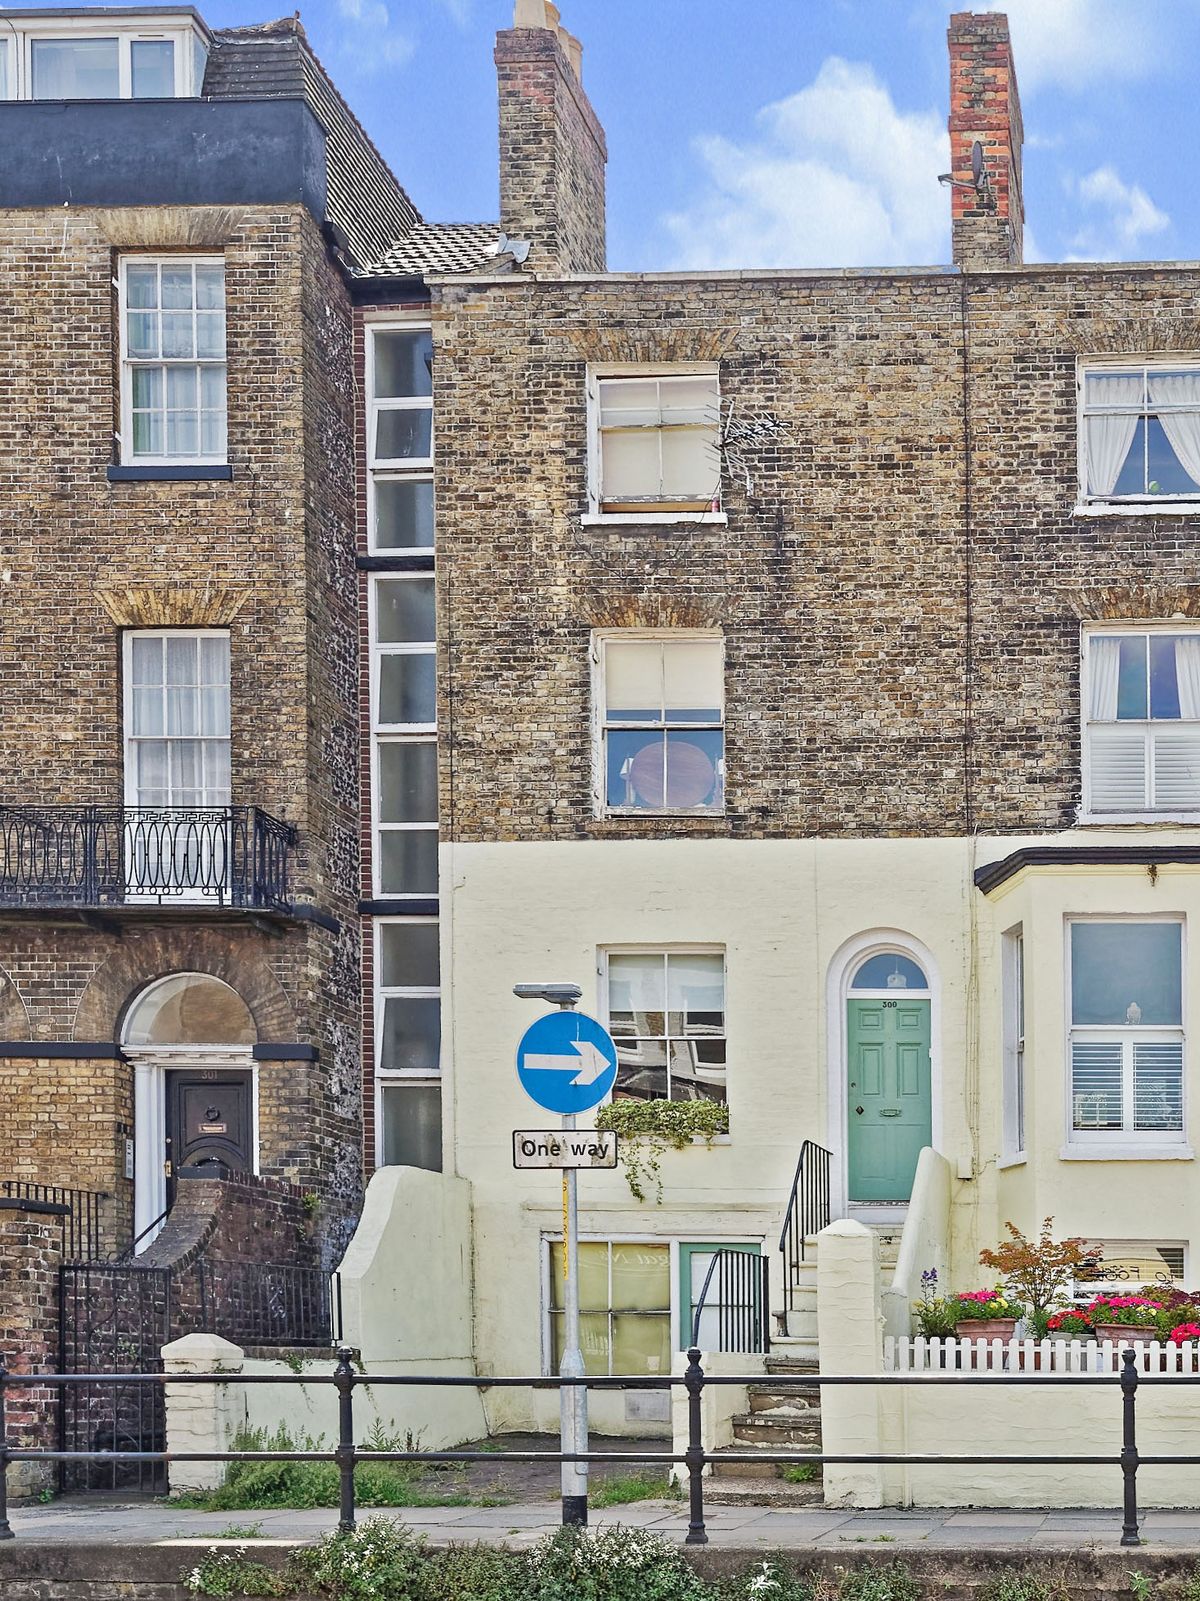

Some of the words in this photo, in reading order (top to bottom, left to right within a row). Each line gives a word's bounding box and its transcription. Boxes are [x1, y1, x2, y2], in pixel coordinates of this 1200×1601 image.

[882, 1000, 898, 1009] 300
[201, 1070, 218, 1080] 301
[521, 1139, 561, 1157] One
[571, 1143, 609, 1160] way
